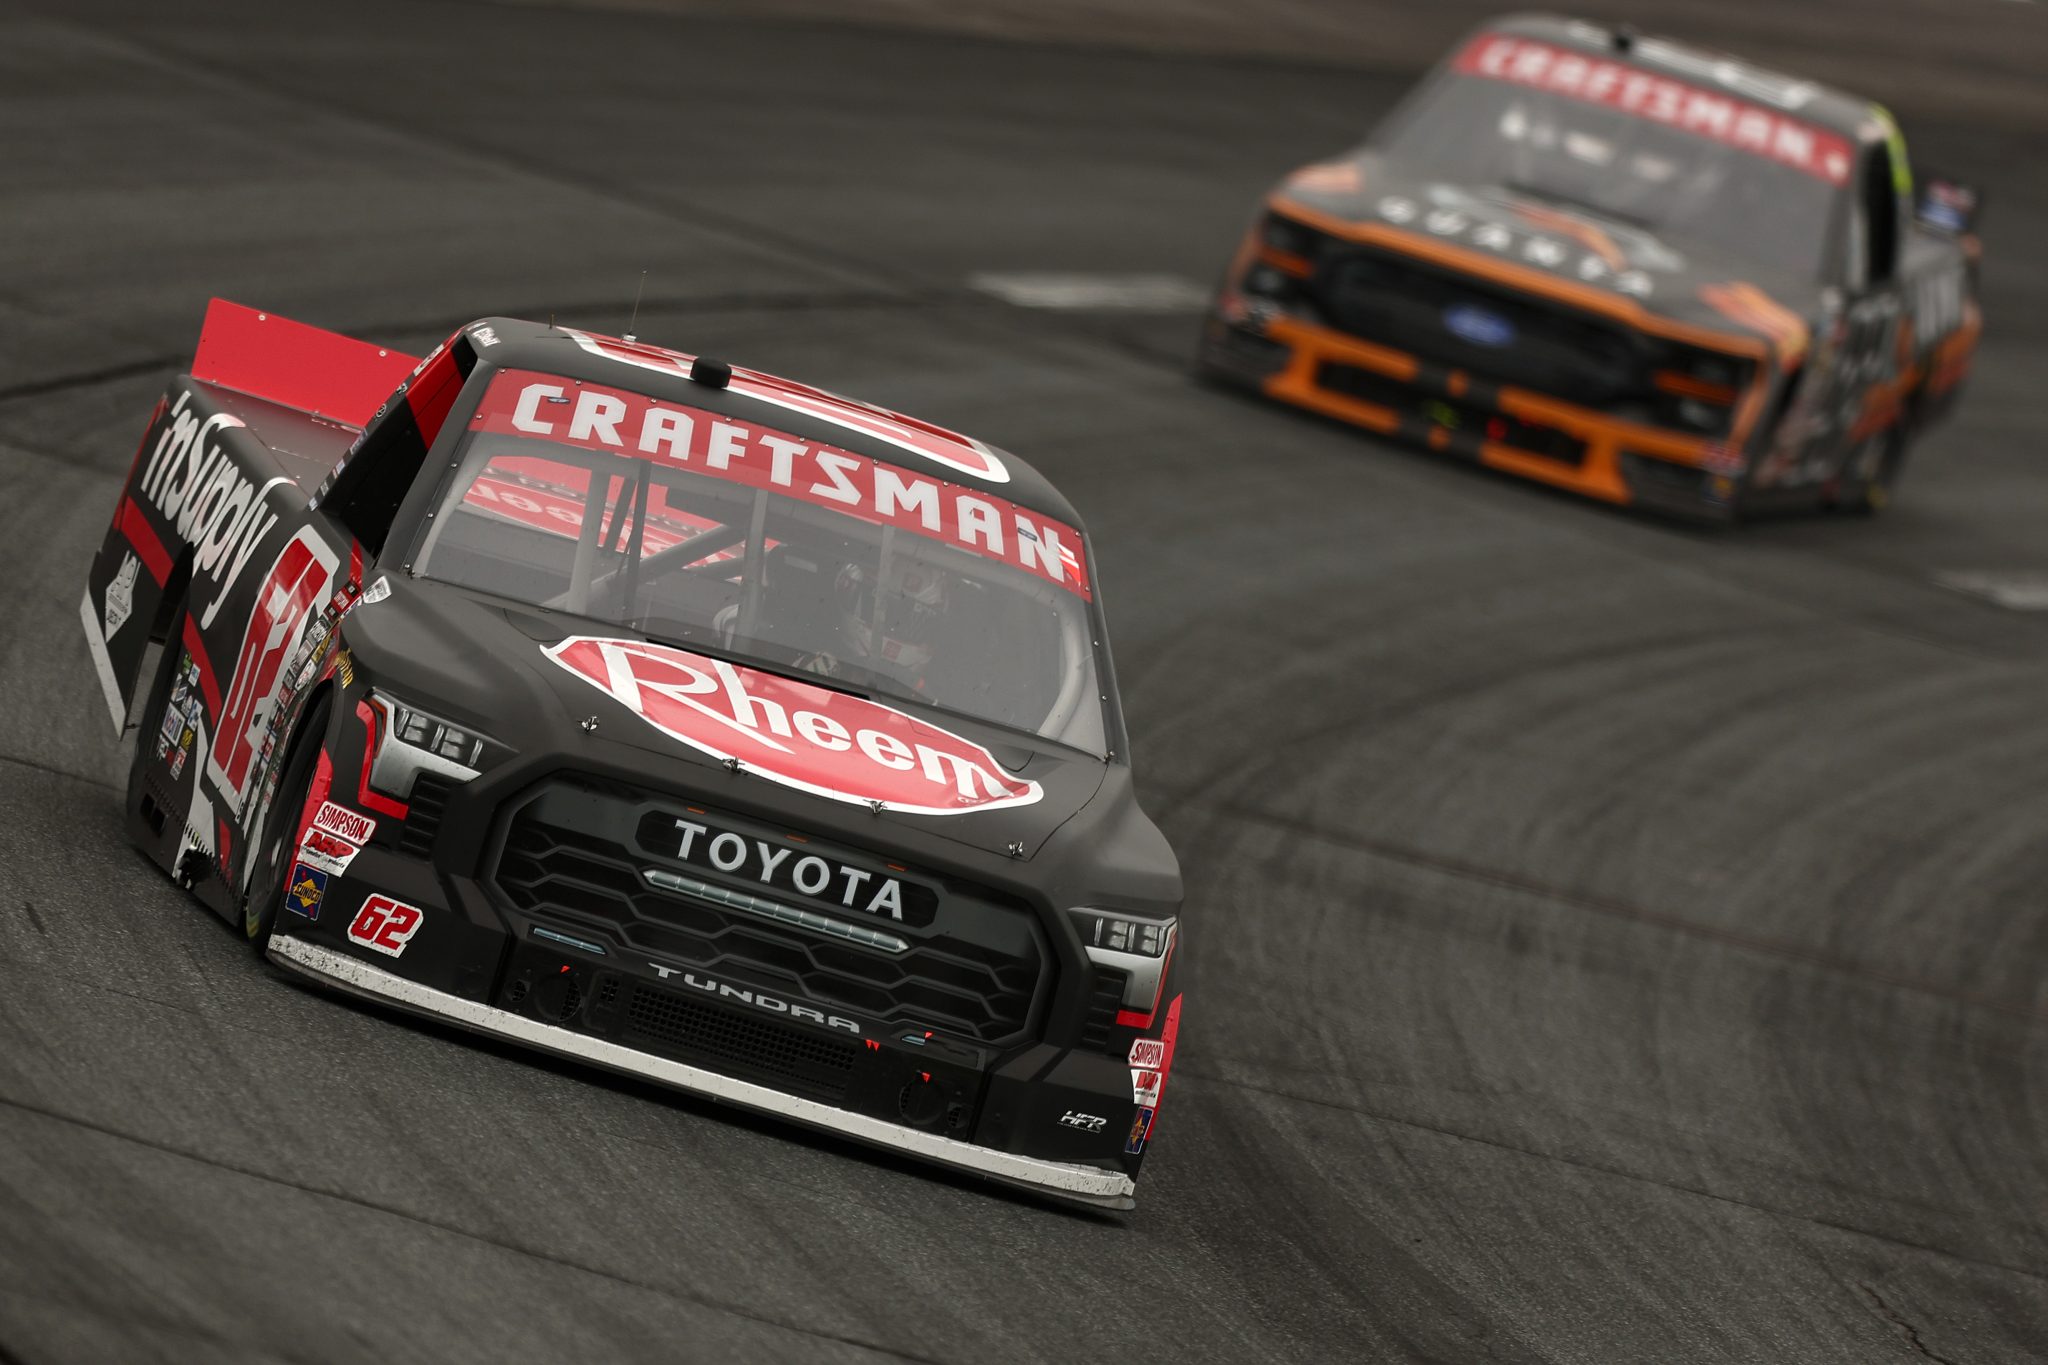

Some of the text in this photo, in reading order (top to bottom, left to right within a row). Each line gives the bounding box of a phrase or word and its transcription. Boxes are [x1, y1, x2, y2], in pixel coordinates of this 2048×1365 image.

[1479, 37, 1814, 164] CRAFTSMAN
[511, 383, 1065, 583] CRAFTSMAN
[597, 641, 1015, 801] Rheem
[304, 831, 354, 859] ARP
[318, 803, 371, 842] SIMPSON
[293, 882, 322, 904] SUNOCO
[674, 819, 904, 920] TOYOTA
[348, 894, 423, 956] 62
[648, 963, 861, 1034] TUNDRA
[1131, 1041, 1162, 1066] SIMPSON
